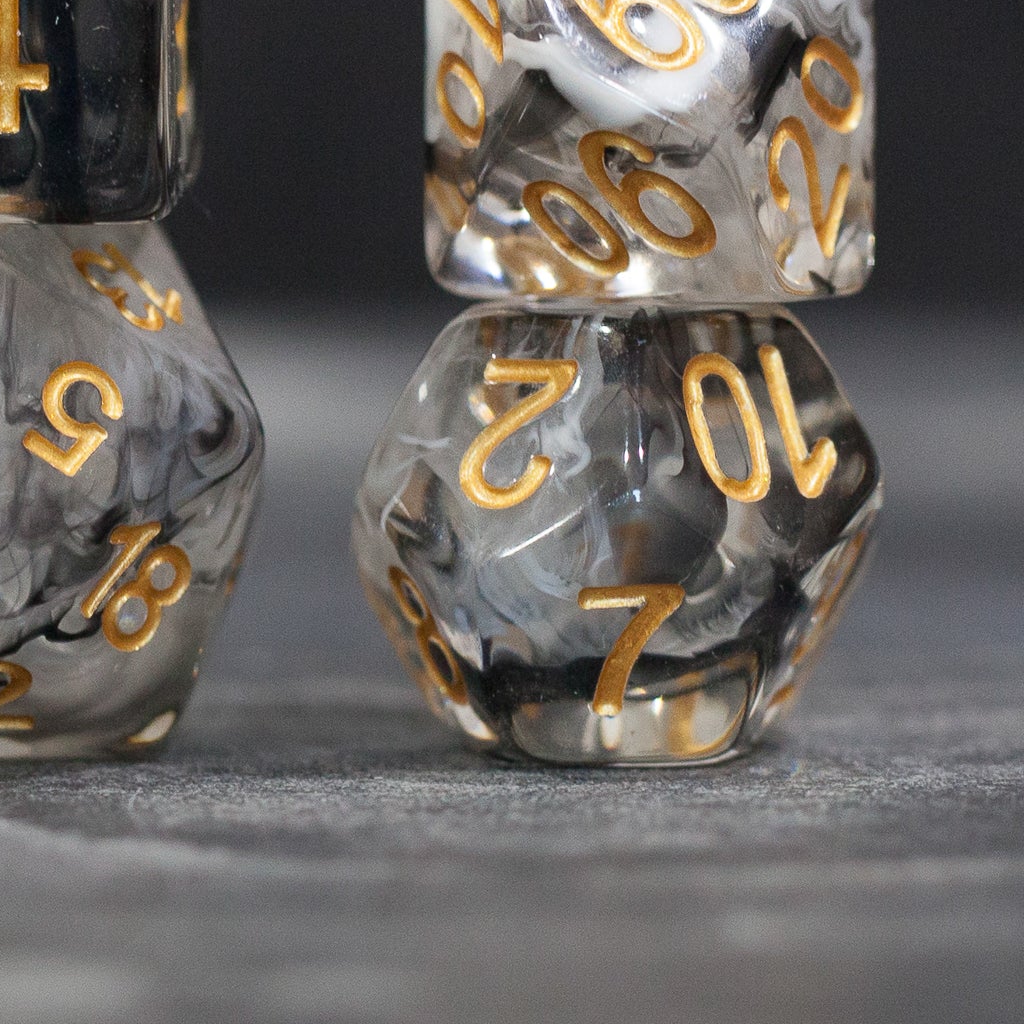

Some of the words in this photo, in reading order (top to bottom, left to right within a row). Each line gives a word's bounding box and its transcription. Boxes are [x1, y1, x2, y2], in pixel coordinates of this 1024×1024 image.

[22, 360, 124, 477] 5
[459, 355, 579, 510] 2
[682, 344, 838, 504] 10
[80, 520, 192, 653] 18
[577, 582, 687, 718] 7
